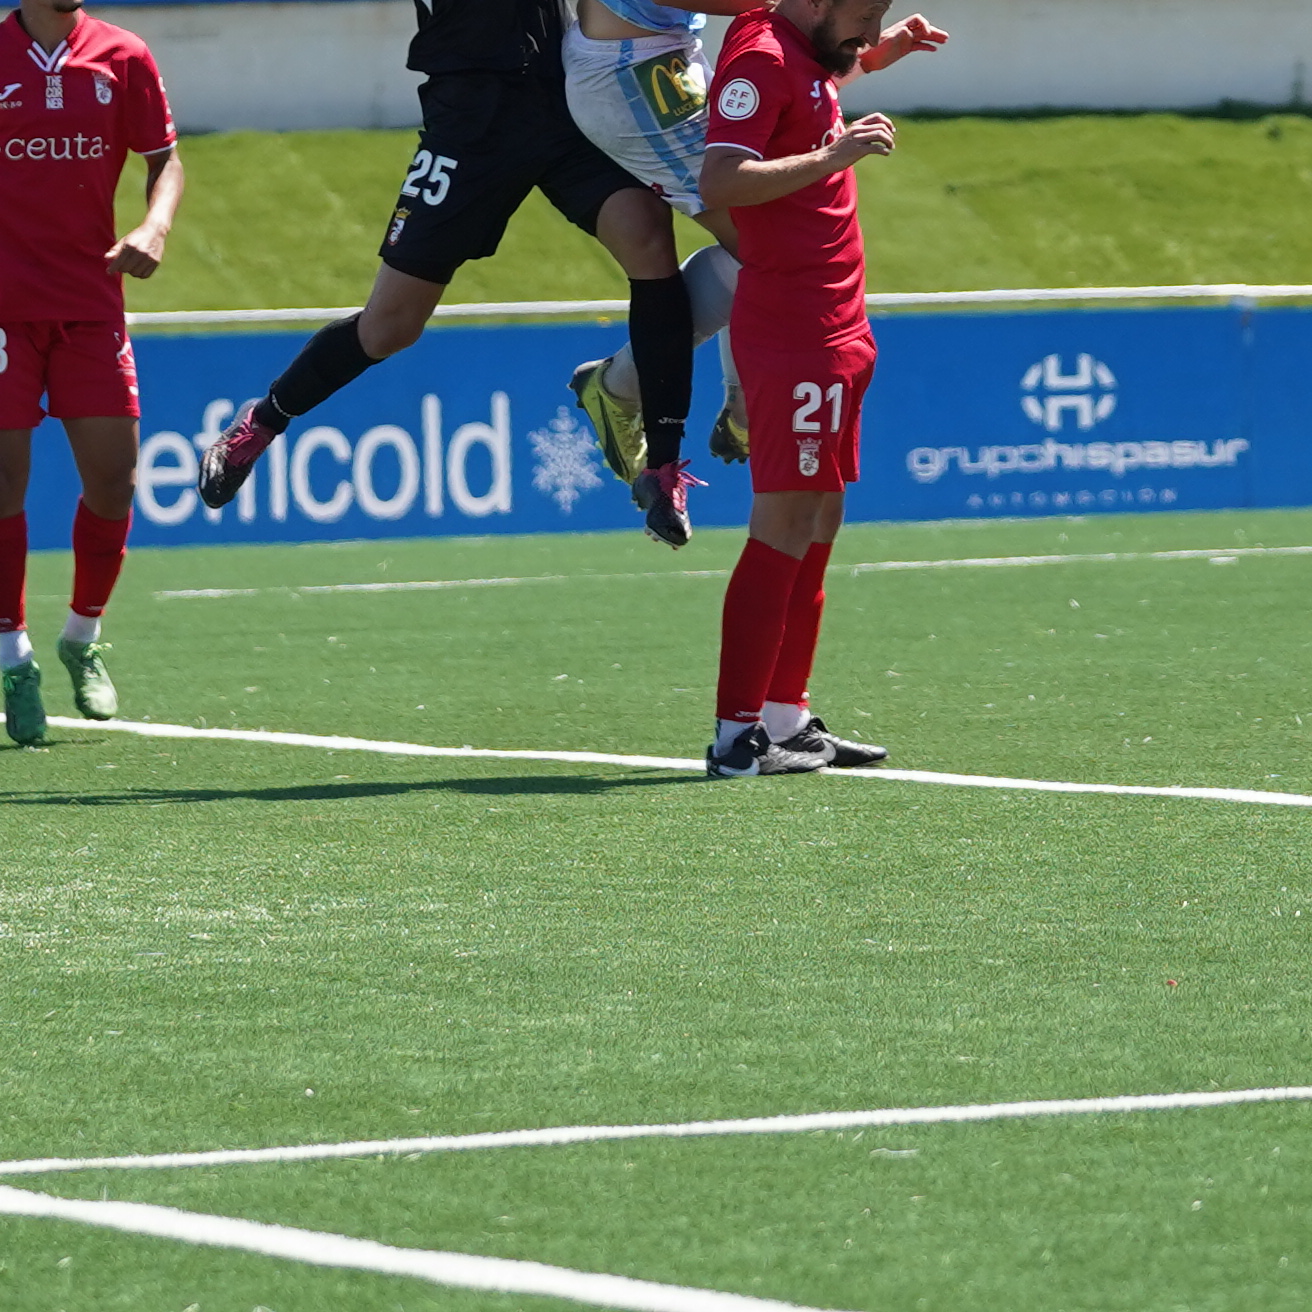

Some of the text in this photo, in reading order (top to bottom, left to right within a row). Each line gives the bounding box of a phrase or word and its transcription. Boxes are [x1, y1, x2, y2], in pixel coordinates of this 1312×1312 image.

[4, 132, 104, 160] ceuta
[400, 149, 458, 206] 25
[792, 382, 843, 433] 21
